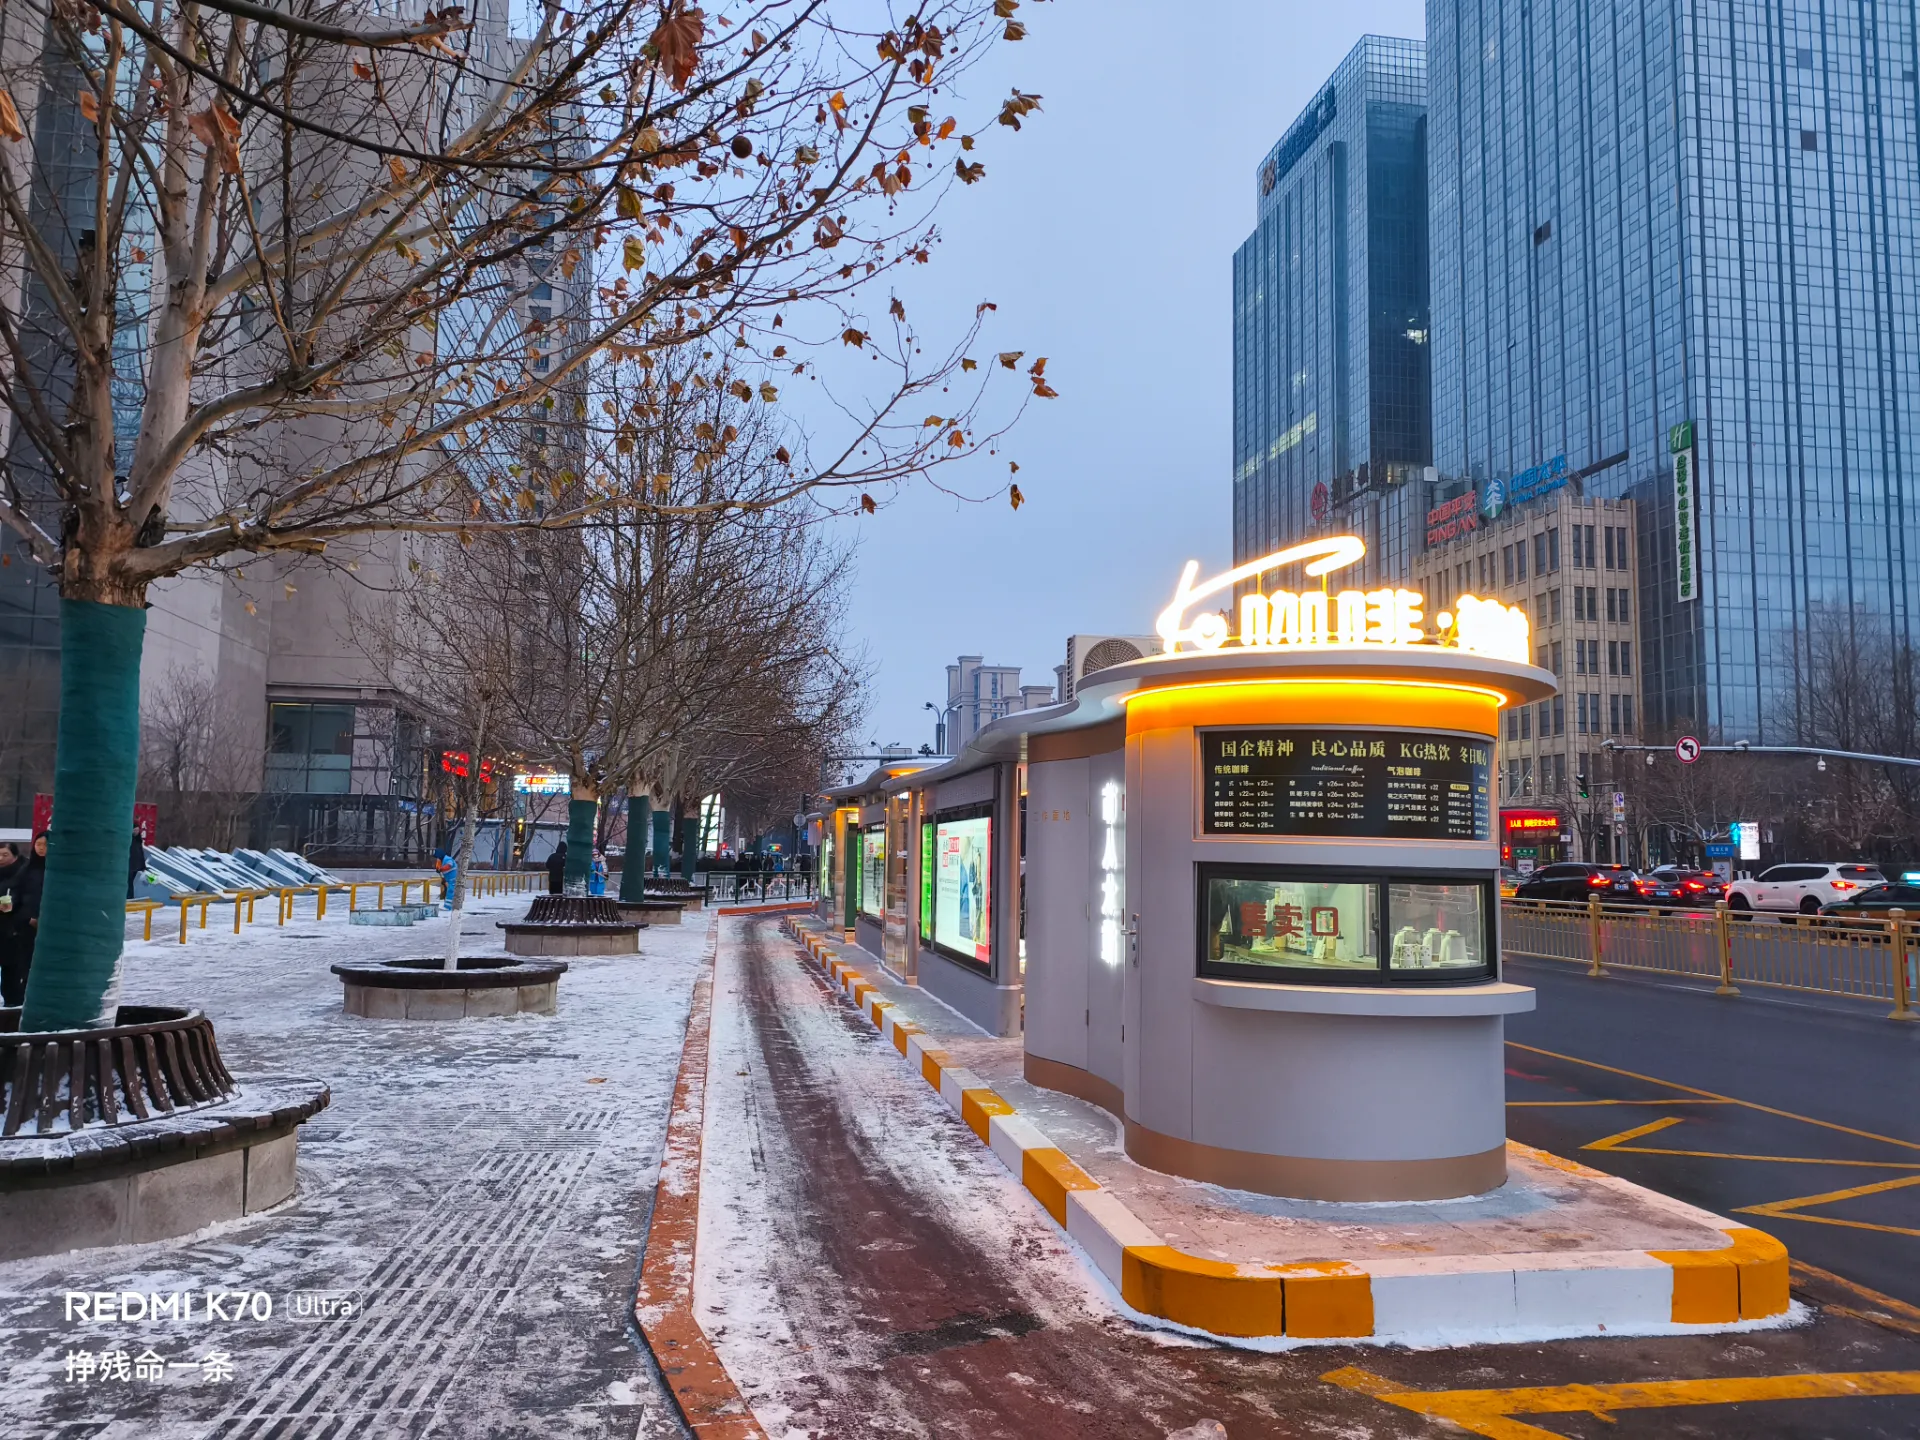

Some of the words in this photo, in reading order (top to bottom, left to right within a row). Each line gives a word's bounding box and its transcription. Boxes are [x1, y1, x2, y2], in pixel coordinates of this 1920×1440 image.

[1510, 454, 1567, 492] 中国太平
[1427, 490, 1477, 525] 中国平安
[1221, 739, 1294, 757] 国企精神
[1311, 739, 1386, 758] 良心品质
[1400, 743, 1450, 761] KG热饮
[1459, 746, 1487, 766] 冬日暖心
[1214, 764, 1249, 774] 传统咖啡
[1345, 765, 1364, 774] coffee
[1387, 766, 1421, 776] 气泡咖啡
[1240, 902, 1339, 938] 售卖口
